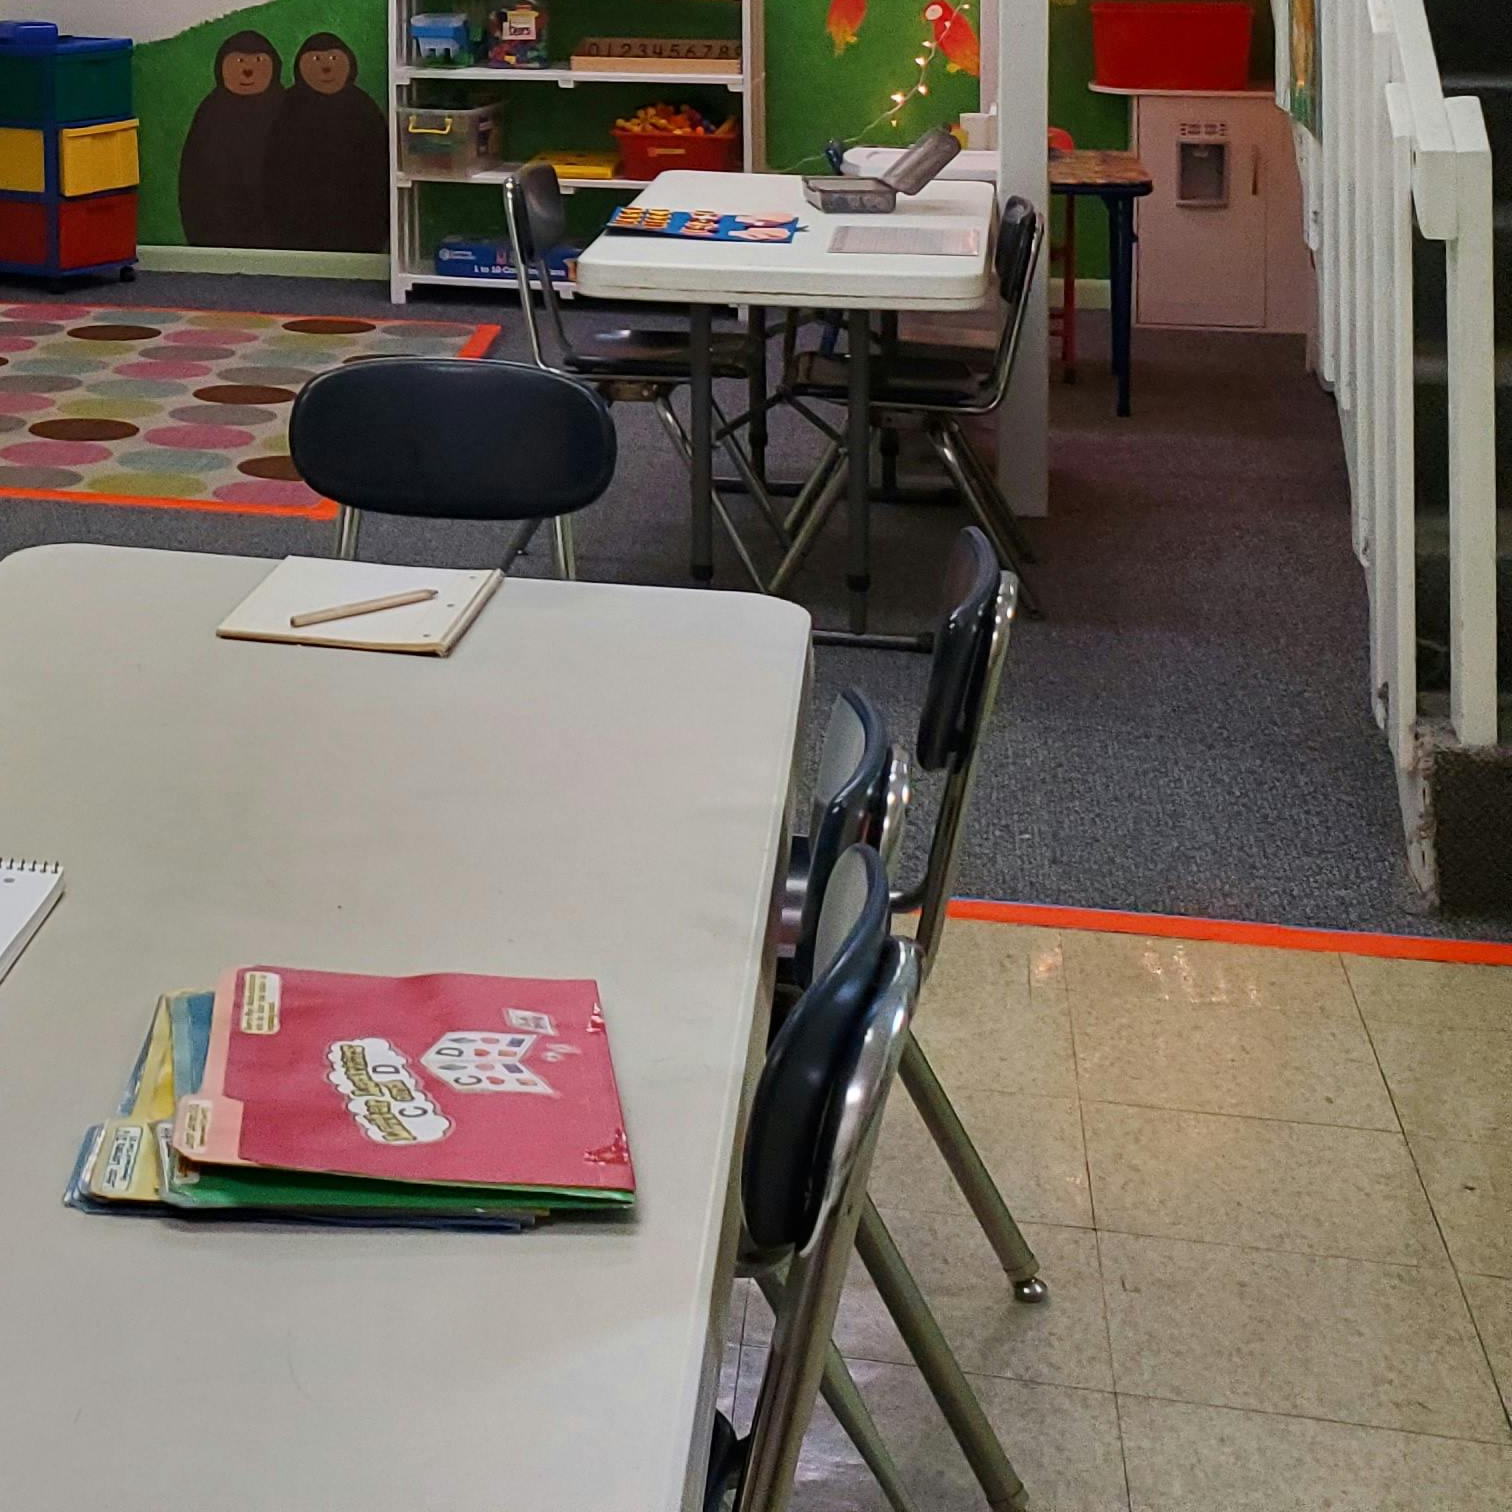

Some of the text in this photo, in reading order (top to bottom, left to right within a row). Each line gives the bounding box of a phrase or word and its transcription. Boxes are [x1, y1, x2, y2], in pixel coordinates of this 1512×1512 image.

[621, 43, 631, 56] 2
[638, 43, 647, 56] 3
[652, 44, 663, 56] 4
[670, 44, 680, 57] 5
[703, 44, 712, 57] 7
[436, 1047, 464, 1058] D
[372, 1064, 400, 1075] D
[454, 1074, 482, 1087] C
[398, 1106, 428, 1118] C
